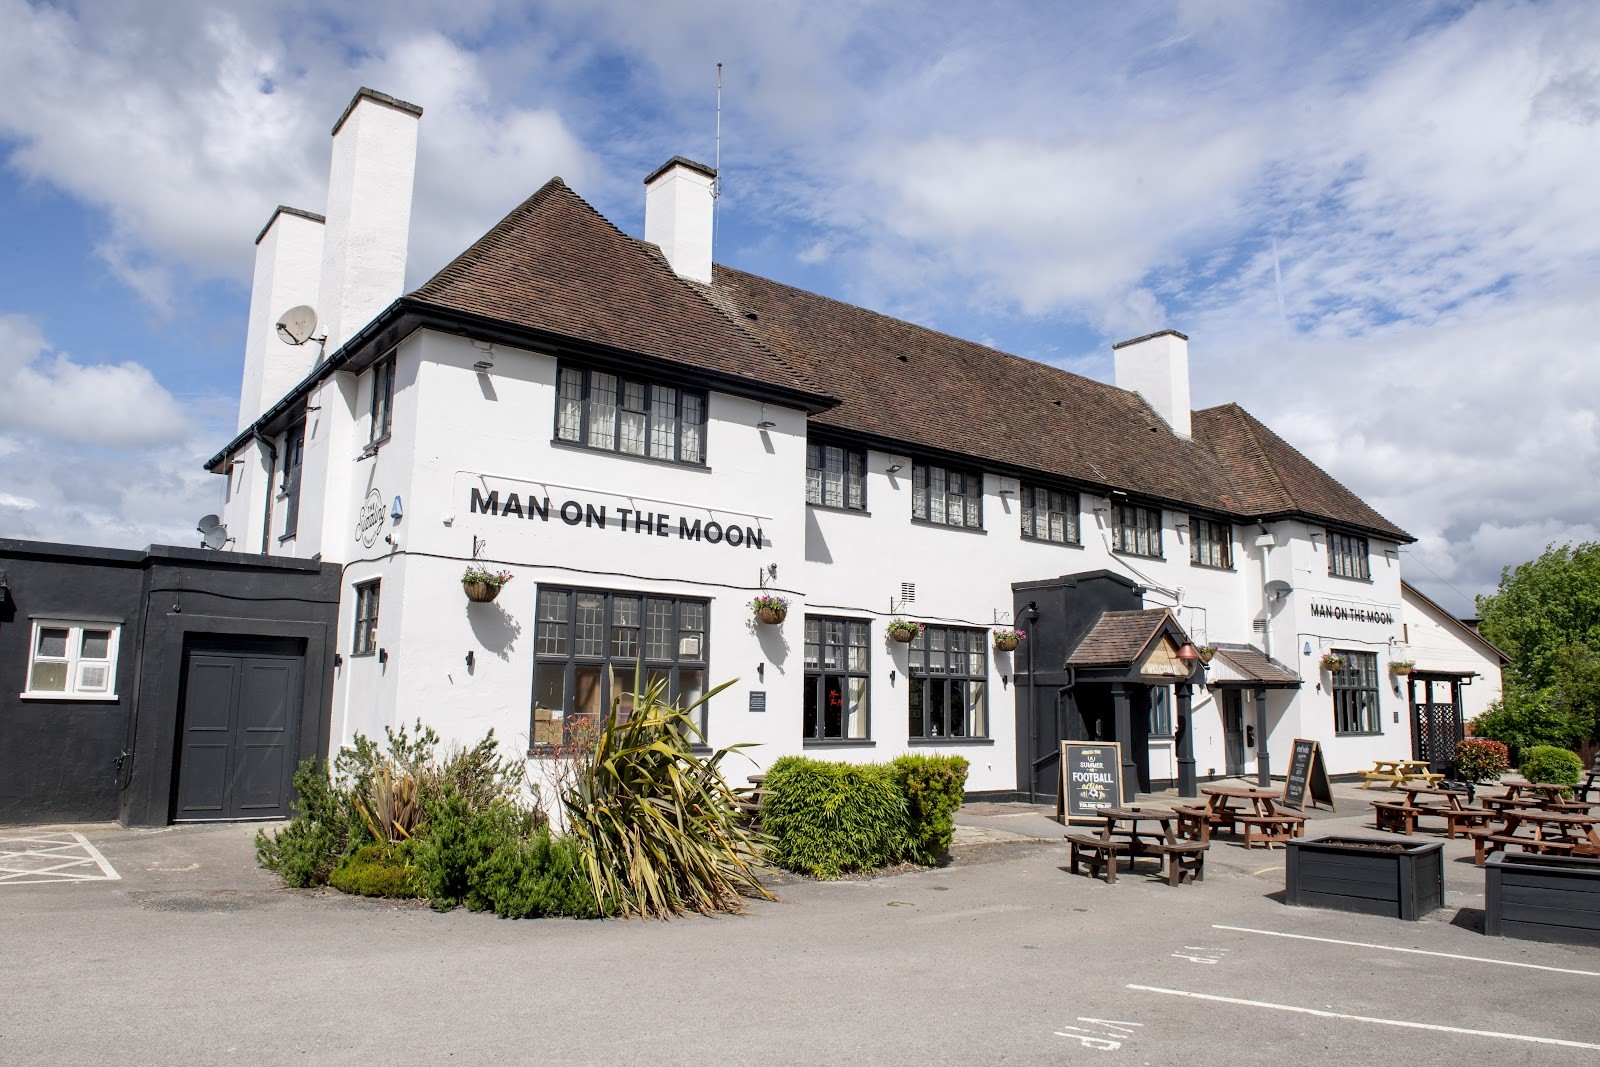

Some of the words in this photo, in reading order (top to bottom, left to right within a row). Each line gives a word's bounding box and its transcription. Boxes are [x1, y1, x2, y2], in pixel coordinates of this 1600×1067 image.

[470, 487, 549, 522] MAN
[560, 500, 606, 530] ON
[616, 507, 670, 538] THE
[679, 516, 762, 550] MOON
[1310, 603, 1332, 618] MAN
[1334, 606, 1348, 621] ON
[1349, 608, 1365, 623] THE
[1366, 610, 1392, 625] MOON
[1146, 664, 1177, 674] WELCOME
[1080, 761, 1104, 769] SUMMER
[1072, 772, 1114, 783] FOOTBALL
